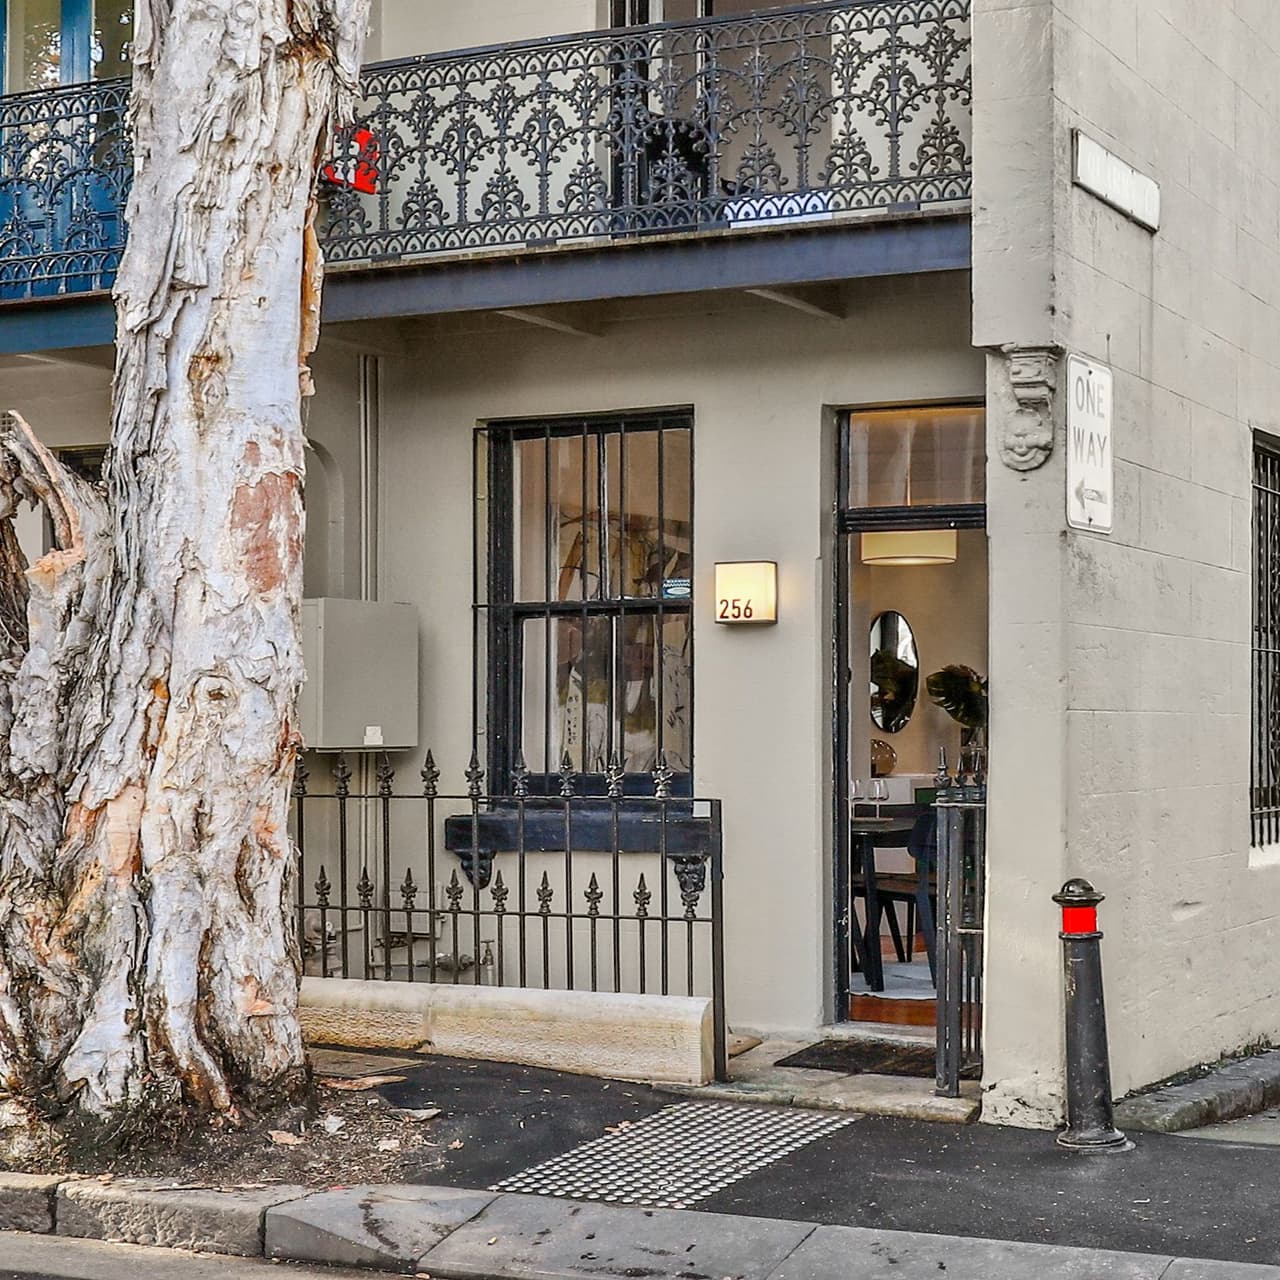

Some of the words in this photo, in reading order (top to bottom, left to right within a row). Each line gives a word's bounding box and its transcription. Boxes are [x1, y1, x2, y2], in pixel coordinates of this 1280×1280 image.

[1075, 375, 1105, 419] ONE
[1073, 426, 1107, 469] WAY
[719, 599, 753, 619] 256
